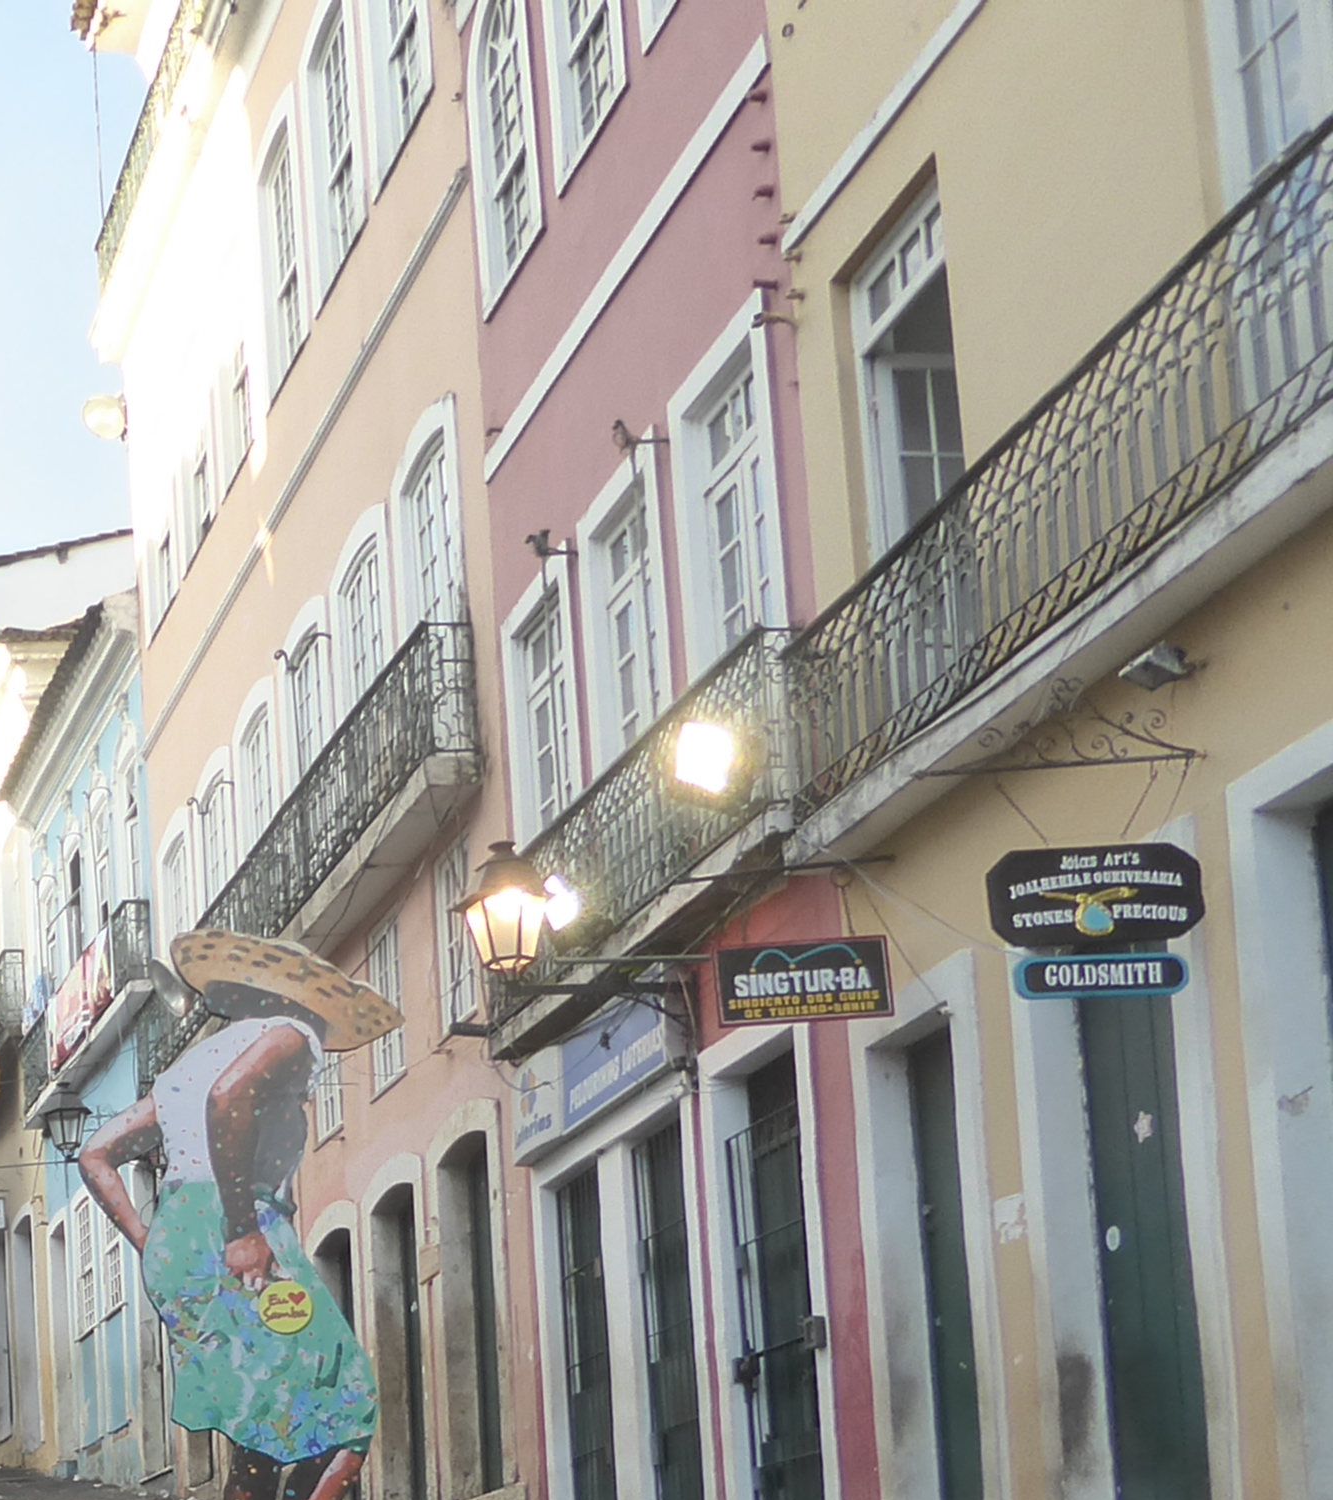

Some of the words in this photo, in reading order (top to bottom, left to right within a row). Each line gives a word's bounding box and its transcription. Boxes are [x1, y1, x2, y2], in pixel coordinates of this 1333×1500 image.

[1012, 909, 1074, 928] STONES
[1112, 904, 1188, 922] PRECIOUS
[1044, 962, 1162, 987] GOLDSMITH
[728, 995, 800, 1010] SINDICATO
[806, 992, 833, 1004] DOS
[839, 989, 881, 1001] GUIAS
[744, 1009, 763, 1019] DE
[268, 1293, 289, 1306] Eu
[263, 1305, 309, 1322] Samba
